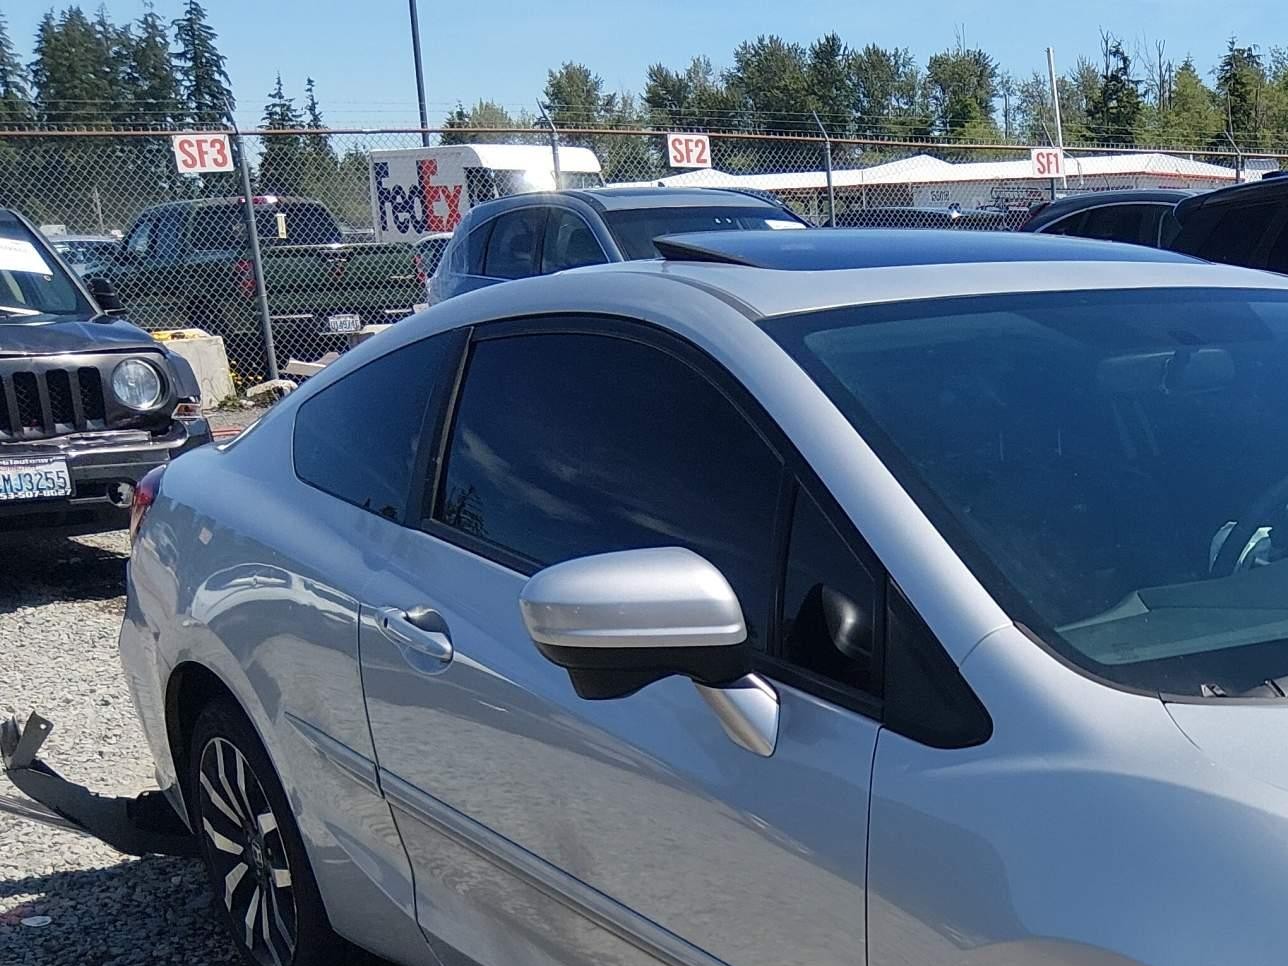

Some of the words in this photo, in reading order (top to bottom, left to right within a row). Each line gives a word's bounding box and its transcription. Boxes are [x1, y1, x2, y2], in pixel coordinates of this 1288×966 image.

[178, 138, 228, 168] SF3
[671, 138, 708, 164] SF2
[1036, 151, 1060, 175] SF1
[373, 159, 463, 234] FedEx
[0, 470, 67, 493] MJ3255
